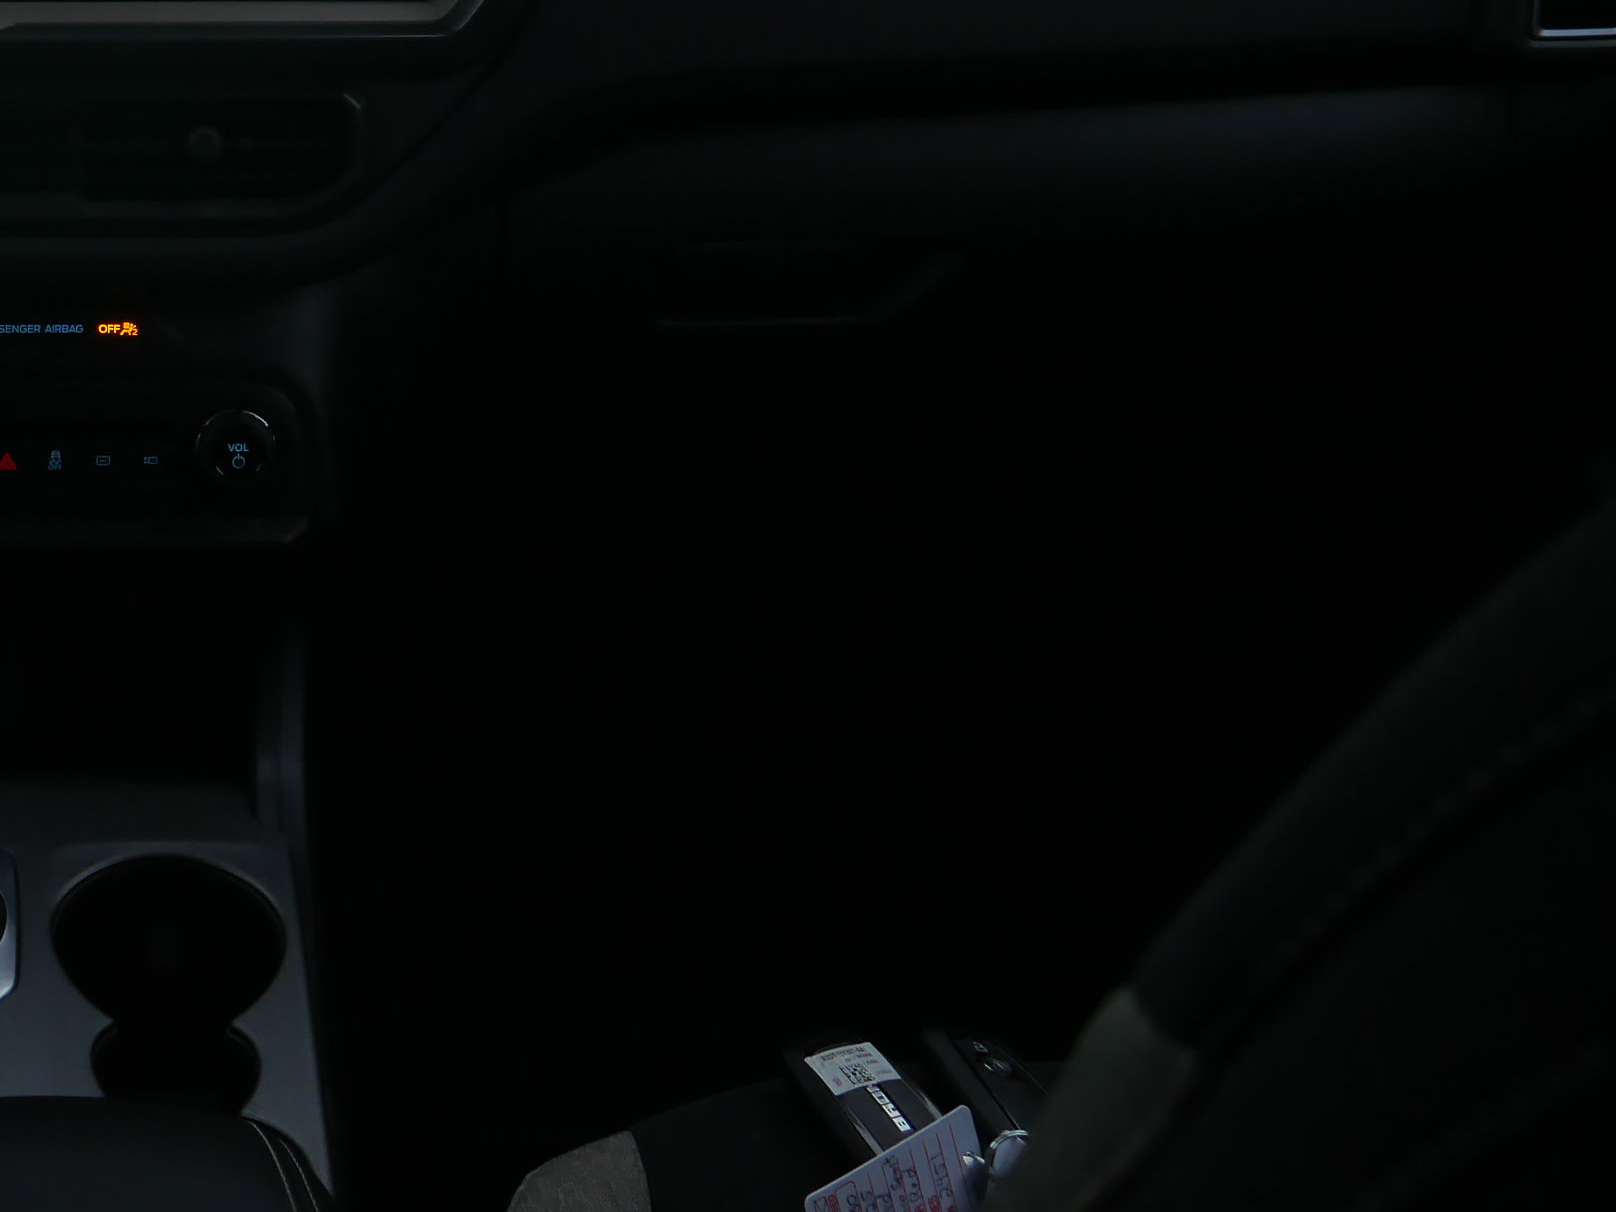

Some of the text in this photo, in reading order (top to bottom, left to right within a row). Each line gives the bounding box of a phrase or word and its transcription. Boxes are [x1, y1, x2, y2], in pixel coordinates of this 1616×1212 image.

[44, 324, 84, 334] AIRBAG
[98, 324, 120, 334] OFF
[228, 443, 250, 452] VOL
